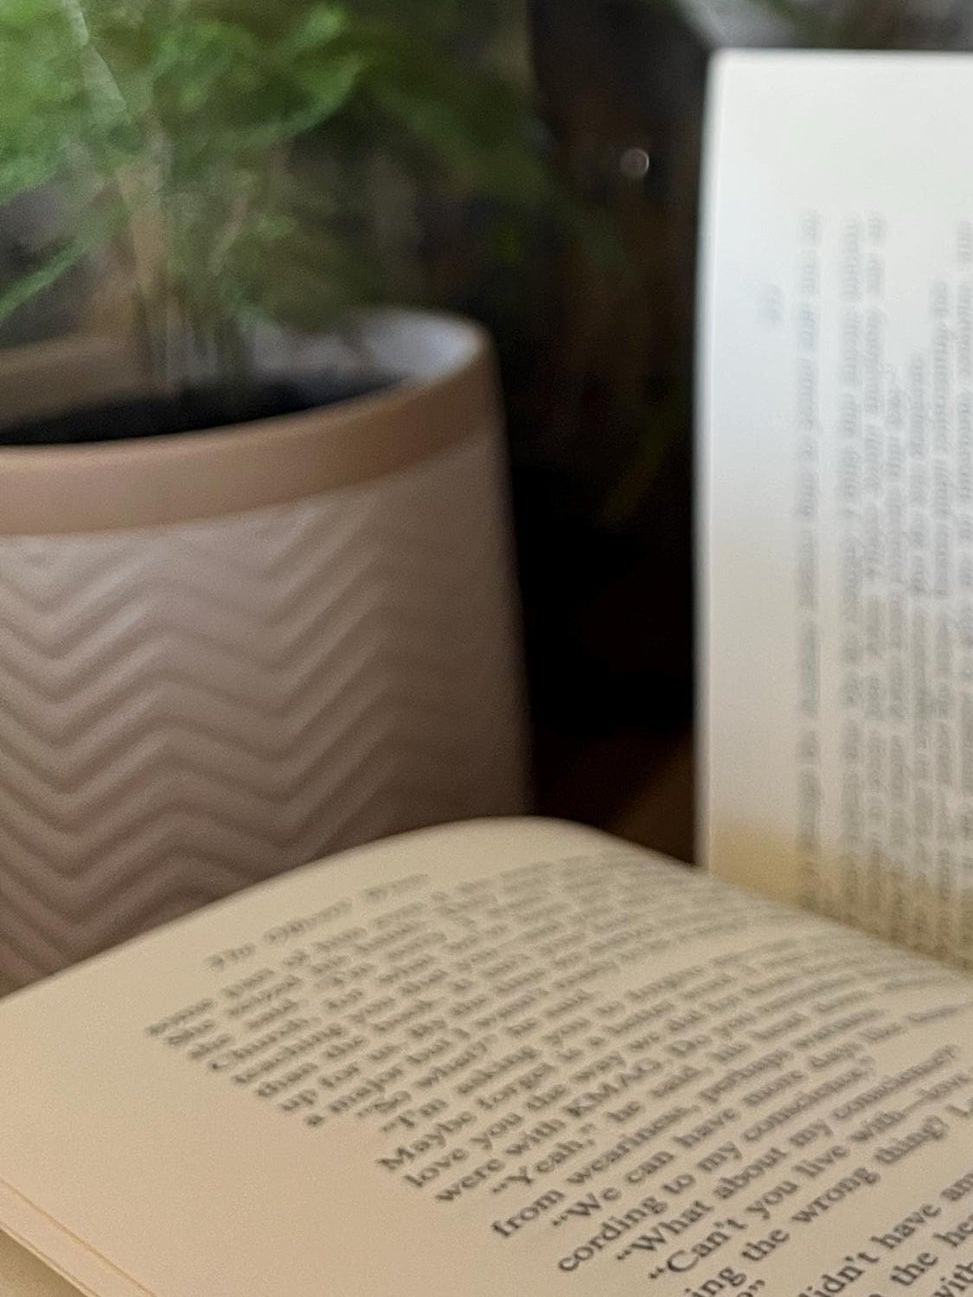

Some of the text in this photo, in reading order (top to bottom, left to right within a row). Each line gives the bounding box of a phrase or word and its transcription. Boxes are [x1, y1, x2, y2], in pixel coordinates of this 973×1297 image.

[377, 1112, 475, 1172] Maybe
[476, 1063, 556, 1111] forget
[404, 1149, 467, 1188] love
[470, 1113, 524, 1151] you
[525, 1085, 570, 1112] the
[435, 1159, 504, 1201] were
[505, 1120, 566, 1156] with
[606, 1102, 643, 1124] he
[492, 1190, 565, 1238] from
[552, 1188, 619, 1227] “We
[625, 1152, 675, 1185] can
[672, 1109, 738, 1149] have
[558, 1143, 742, 1272] cording to my
[616, 1121, 833, 1261] “What about my
[649, 1146, 848, 1279] “Can't you live
[685, 1267, 746, 1293] ing
[741, 1230, 789, 1262] the
[791, 1168, 880, 1223] wrong
[803, 1253, 879, 1297] idn't
[870, 1205, 941, 1250] have
[890, 1253, 938, 1286] the
